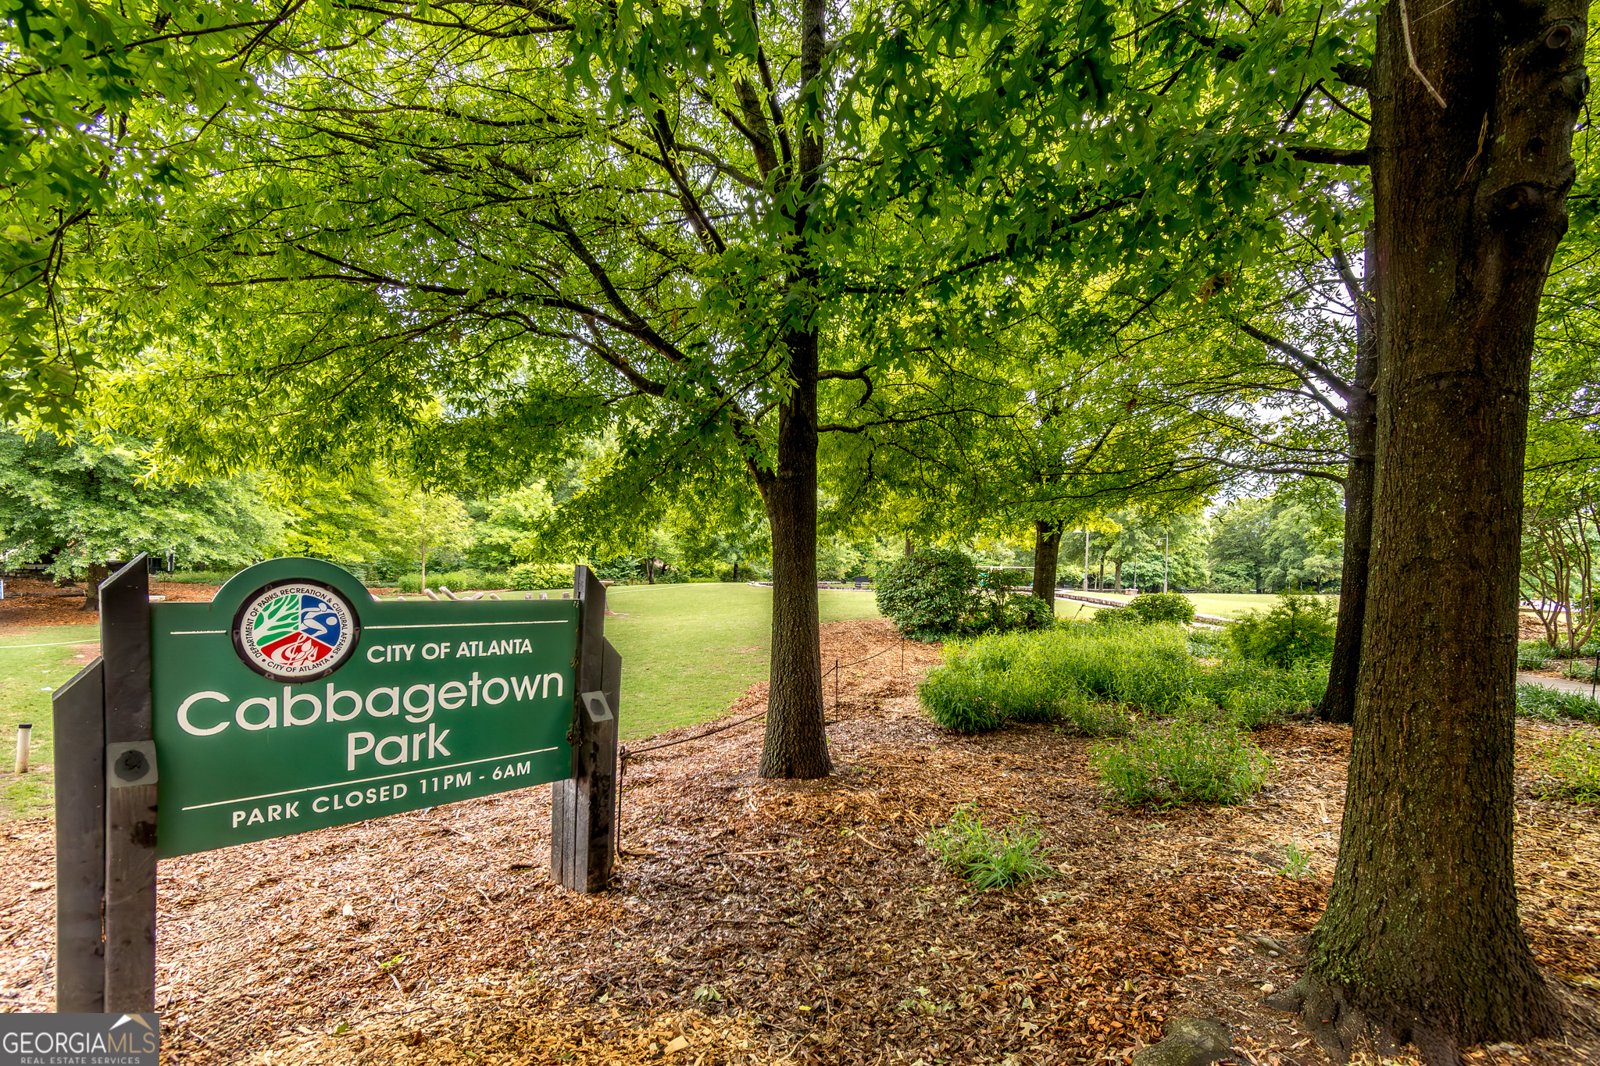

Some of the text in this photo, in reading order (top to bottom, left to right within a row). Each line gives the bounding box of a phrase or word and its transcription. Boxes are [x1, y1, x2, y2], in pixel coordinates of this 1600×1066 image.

[280, 587, 327, 600] RECREATION
[249, 607, 260, 618] OF
[332, 602, 348, 632] CULTURAL
[245, 618, 262, 658] DEPARTMENT
[334, 631, 347, 655] AFFAIRS
[366, 639, 533, 665] CITY OF ATLANTA
[267, 661, 285, 671] CITY
[298, 658, 330, 673] ATLANTA
[176, 671, 564, 736] Cabbagetown
[346, 723, 451, 771] Park
[232, 801, 299, 829] PARK
[312, 782, 408, 814] CLOSED
[419, 771, 472, 795] 11PM
[492, 760, 531, 780] 6AM
